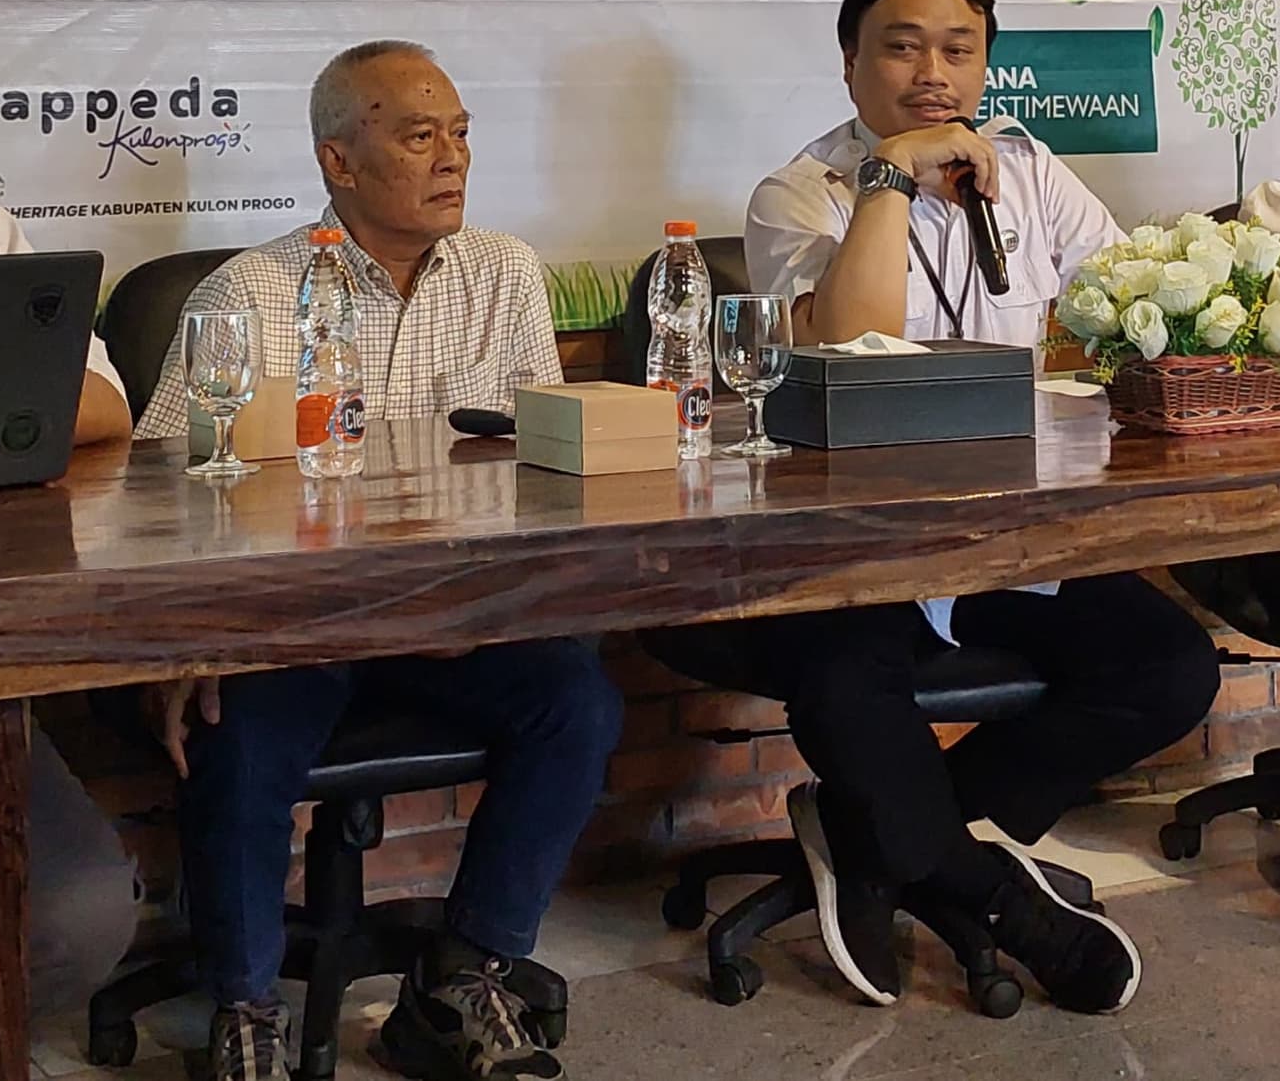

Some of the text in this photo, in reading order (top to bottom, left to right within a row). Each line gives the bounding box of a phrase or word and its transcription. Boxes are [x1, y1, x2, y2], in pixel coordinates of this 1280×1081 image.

[98, 109, 242, 180] Kulonprogo
[4, 197, 296, 219] HERITAGE KABUPATEN KULON PROGO
